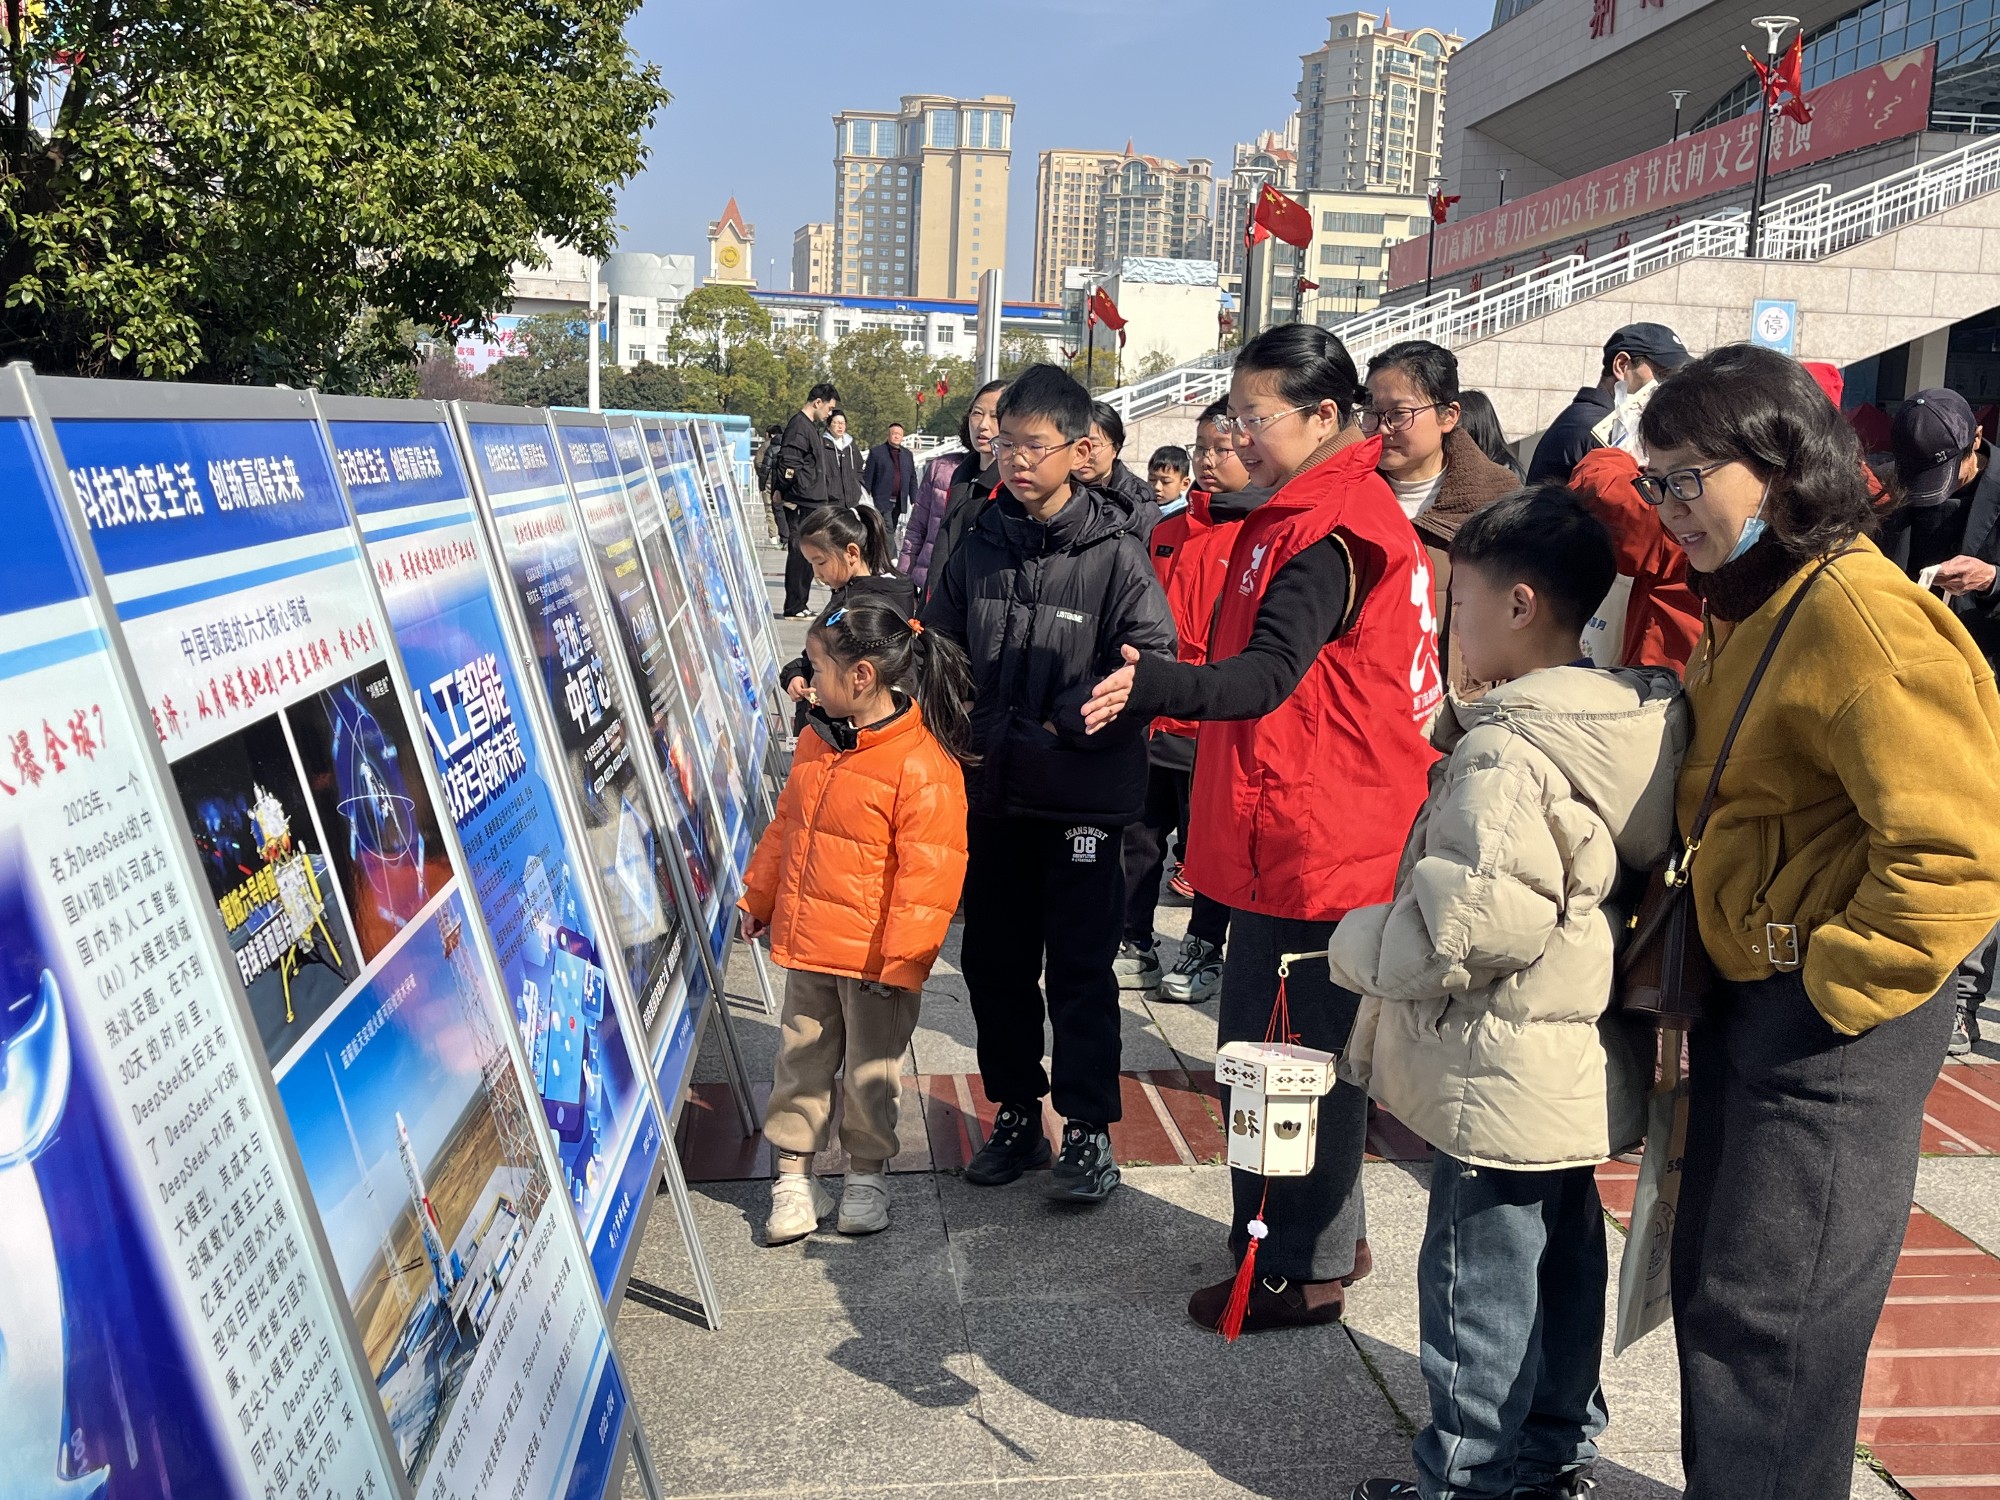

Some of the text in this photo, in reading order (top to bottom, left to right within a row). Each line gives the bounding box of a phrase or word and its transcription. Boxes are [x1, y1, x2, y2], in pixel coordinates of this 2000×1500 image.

[457, 346, 505, 358] 富强 民主
[389, 445, 443, 482] 创新赢得未来
[207, 454, 305, 514] 创新赢得未来
[180, 596, 313, 667] 中国领跑的六大核心领域
[0, 703, 107, 797] 爆全球？
[1065, 826, 1109, 841] JEANSWEST
[1074, 836, 1097, 853] 08
